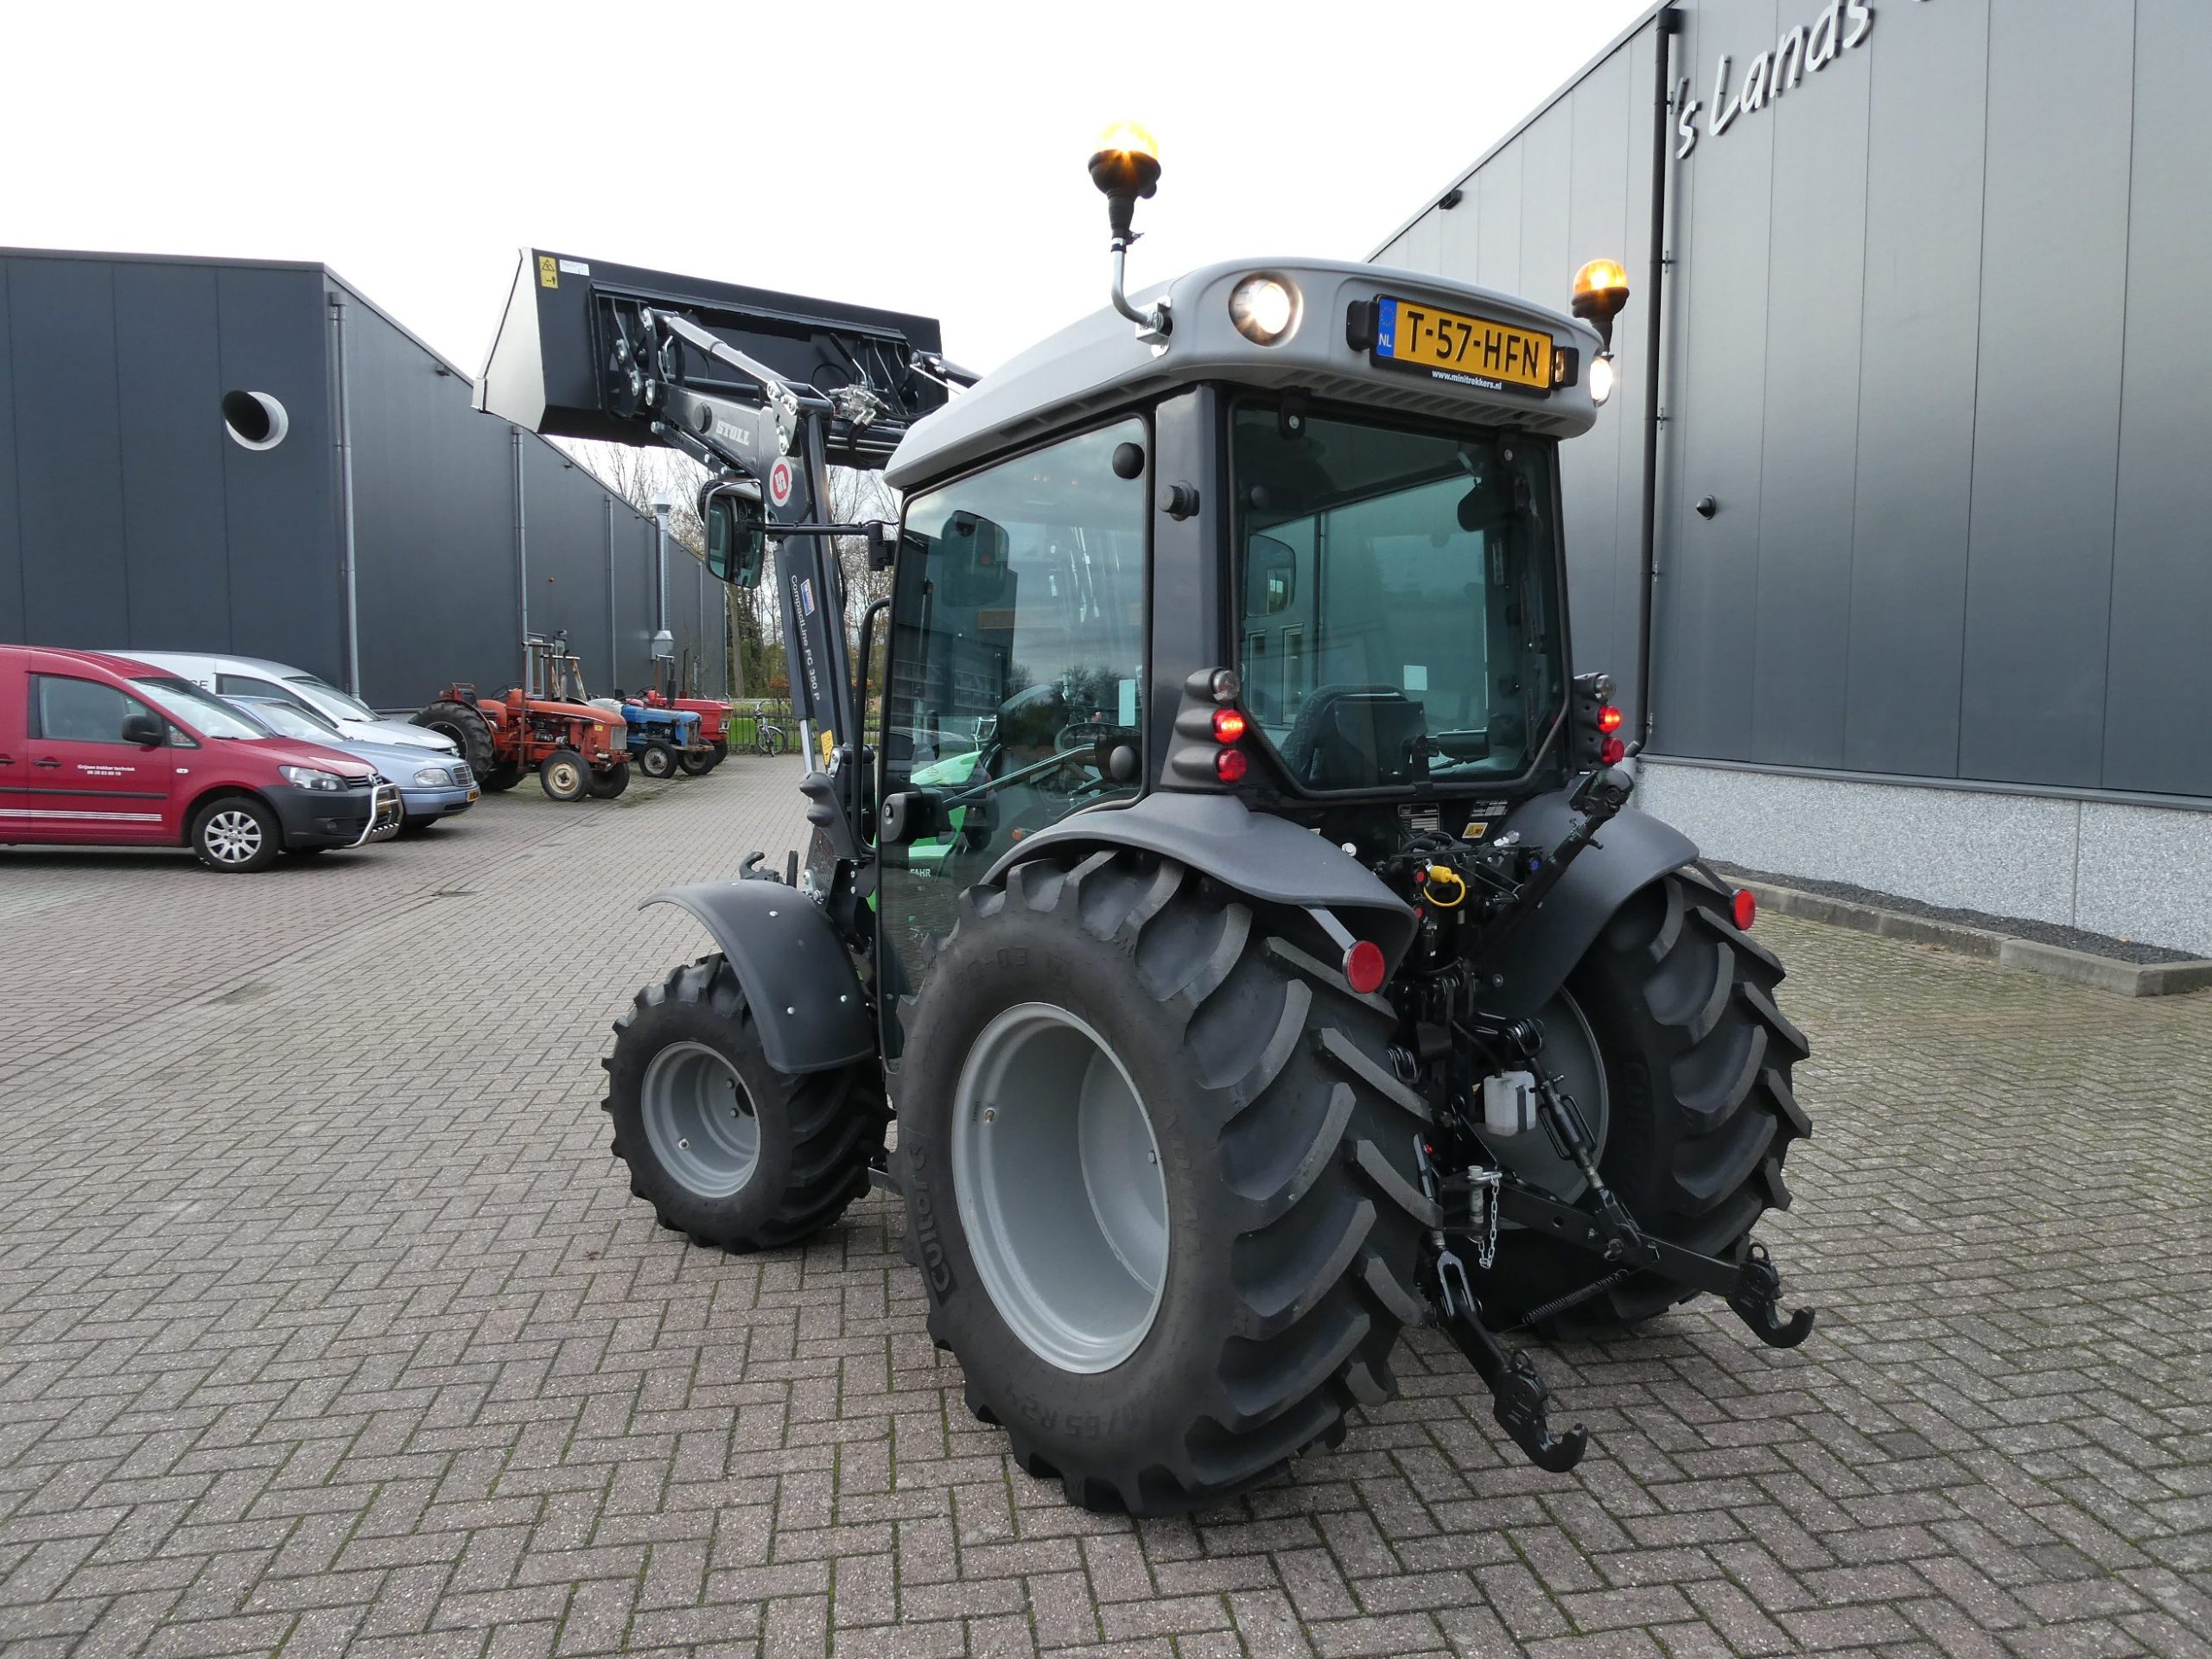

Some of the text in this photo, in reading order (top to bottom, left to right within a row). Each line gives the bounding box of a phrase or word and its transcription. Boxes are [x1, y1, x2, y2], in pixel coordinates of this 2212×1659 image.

[1378, 334, 1392, 347] NL
[1407, 309, 1540, 379] T-57-HFN
[1432, 370, 1502, 391] www.minitrekkers.nl
[715, 420, 751, 447] STOLL
[791, 574, 809, 647] CompactLine
[804, 649, 814, 666] FC
[809, 668, 818, 690] 350
[813, 692, 821, 701] P
